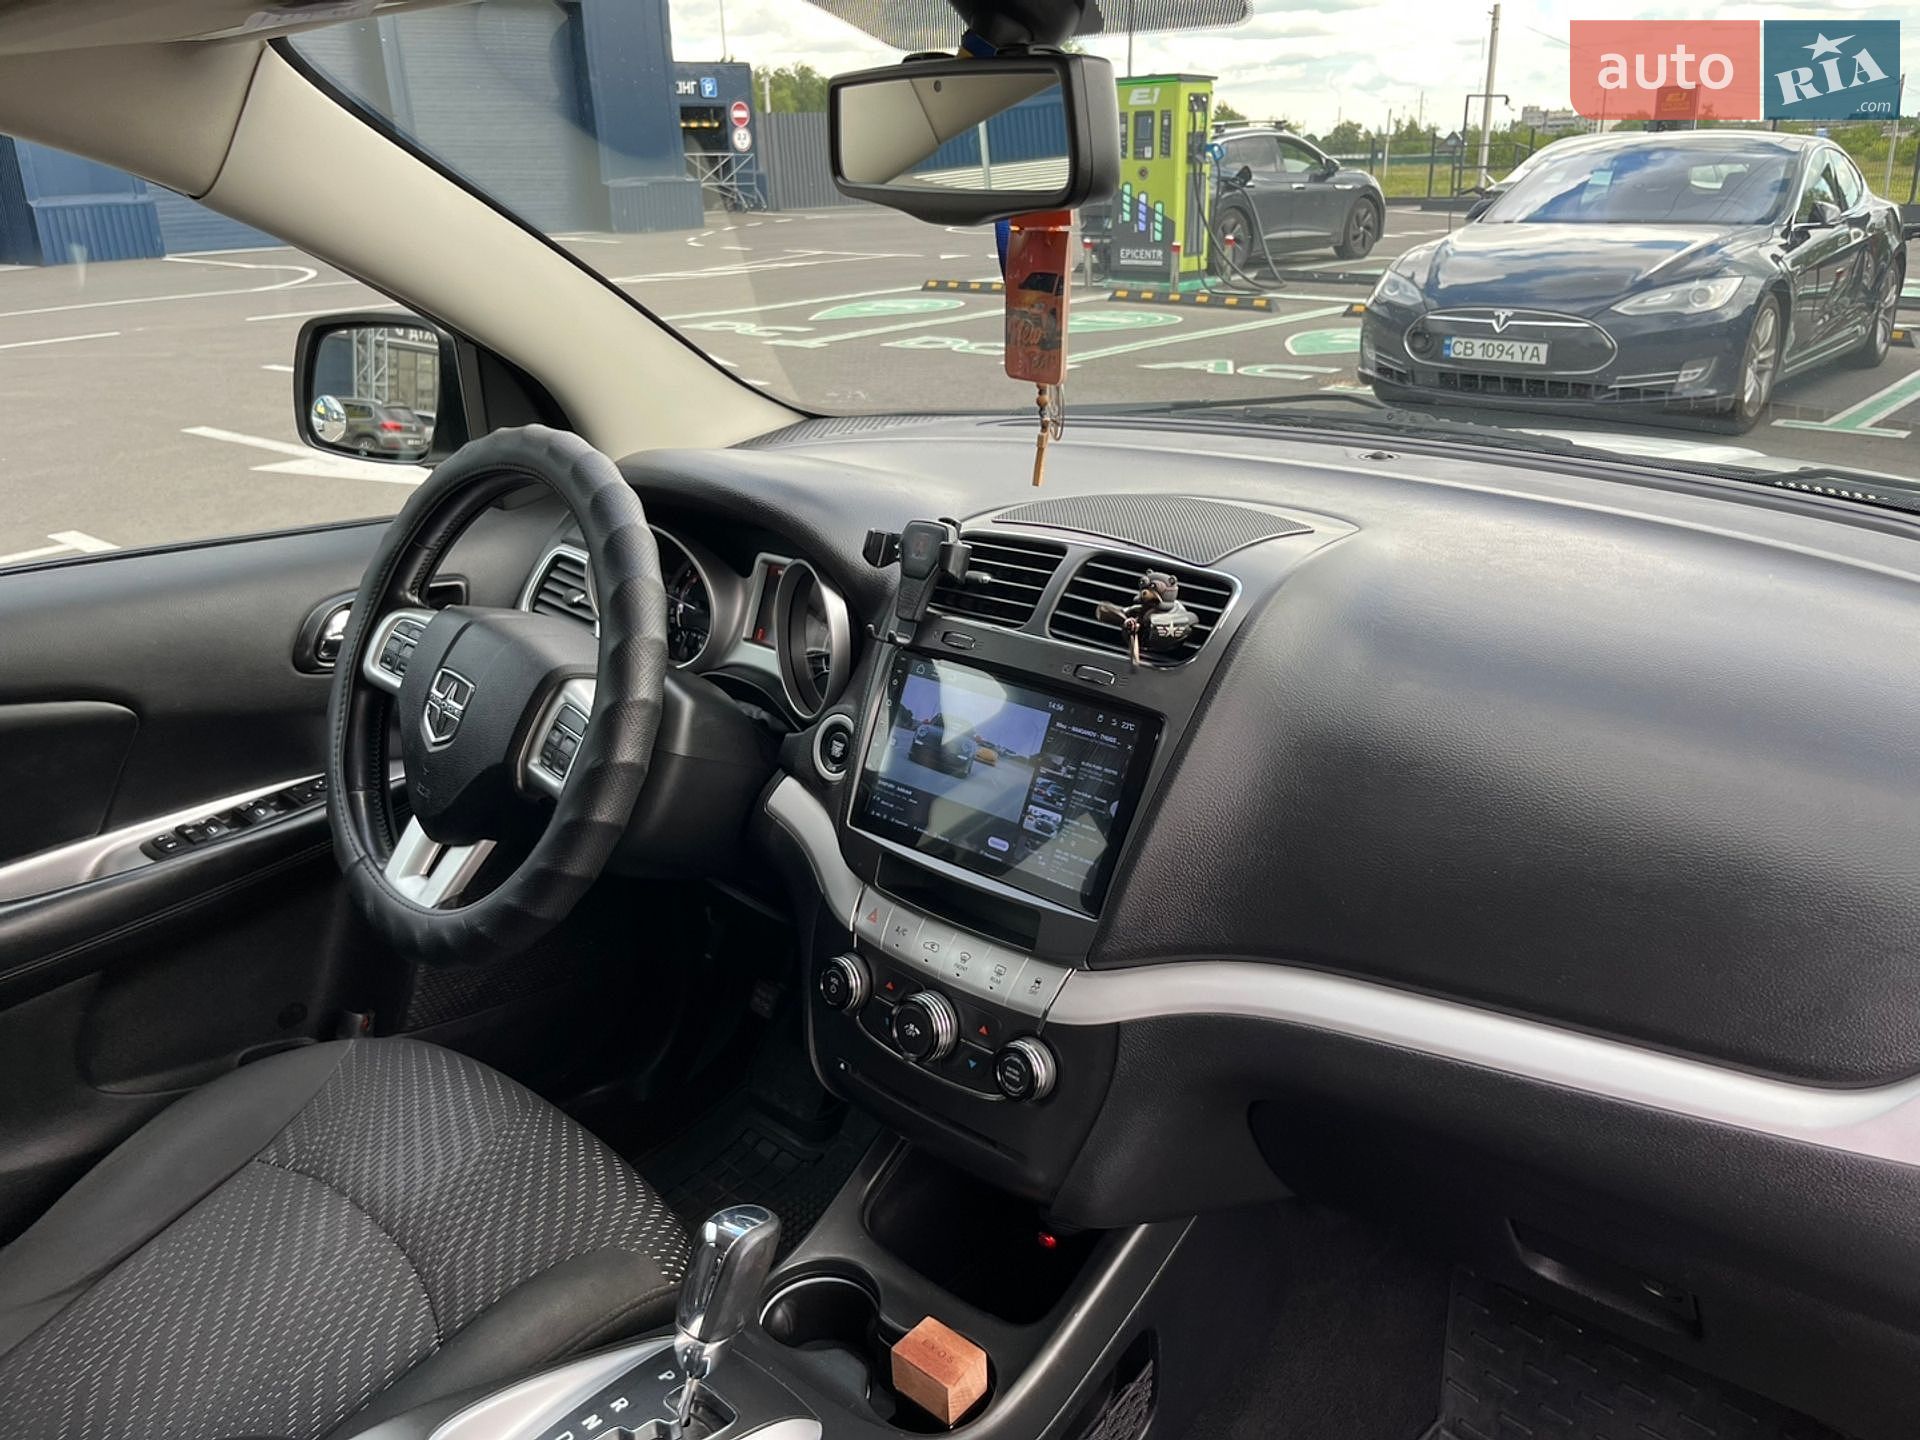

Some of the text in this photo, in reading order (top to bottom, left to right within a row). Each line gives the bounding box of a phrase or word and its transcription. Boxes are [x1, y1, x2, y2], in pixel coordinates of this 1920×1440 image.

[1120, 248, 1163, 260] EPICENTR
[1452, 341, 1541, 362] CB 1094 YA
[658, 1370, 676, 1381] P
[609, 1397, 630, 1413] R
[581, 1414, 603, 1431] N
